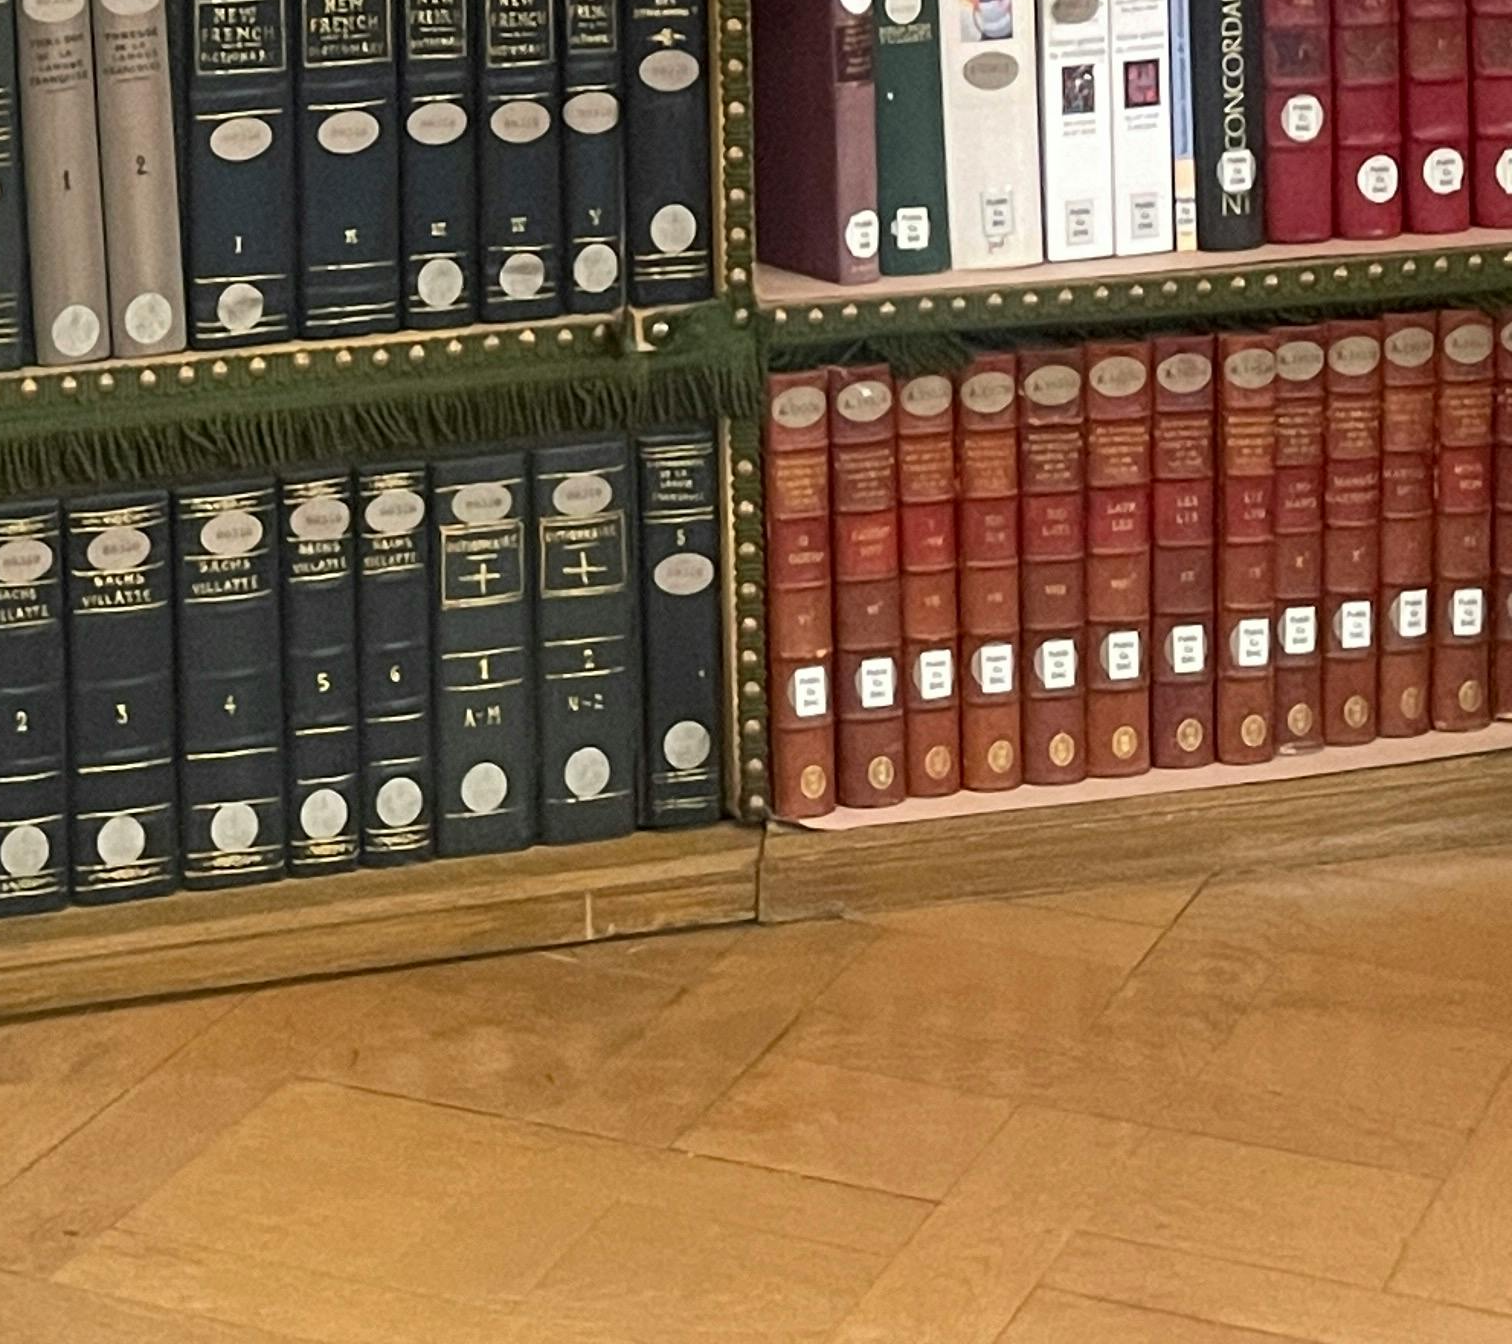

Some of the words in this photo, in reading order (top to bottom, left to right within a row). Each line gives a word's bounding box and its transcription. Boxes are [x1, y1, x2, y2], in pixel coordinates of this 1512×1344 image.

[214, 6, 257, 25] NEW
[310, 15, 380, 34] FRENCH
[202, 25, 275, 43] FRENCH
[137, 154, 148, 176] 2
[389, 664, 401, 683] 6
[479, 658, 488, 680] 1
[316, 672, 331, 693] 5
[116, 703, 129, 725] 3
[223, 694, 237, 716] 4
[16, 710, 29, 732] 2
